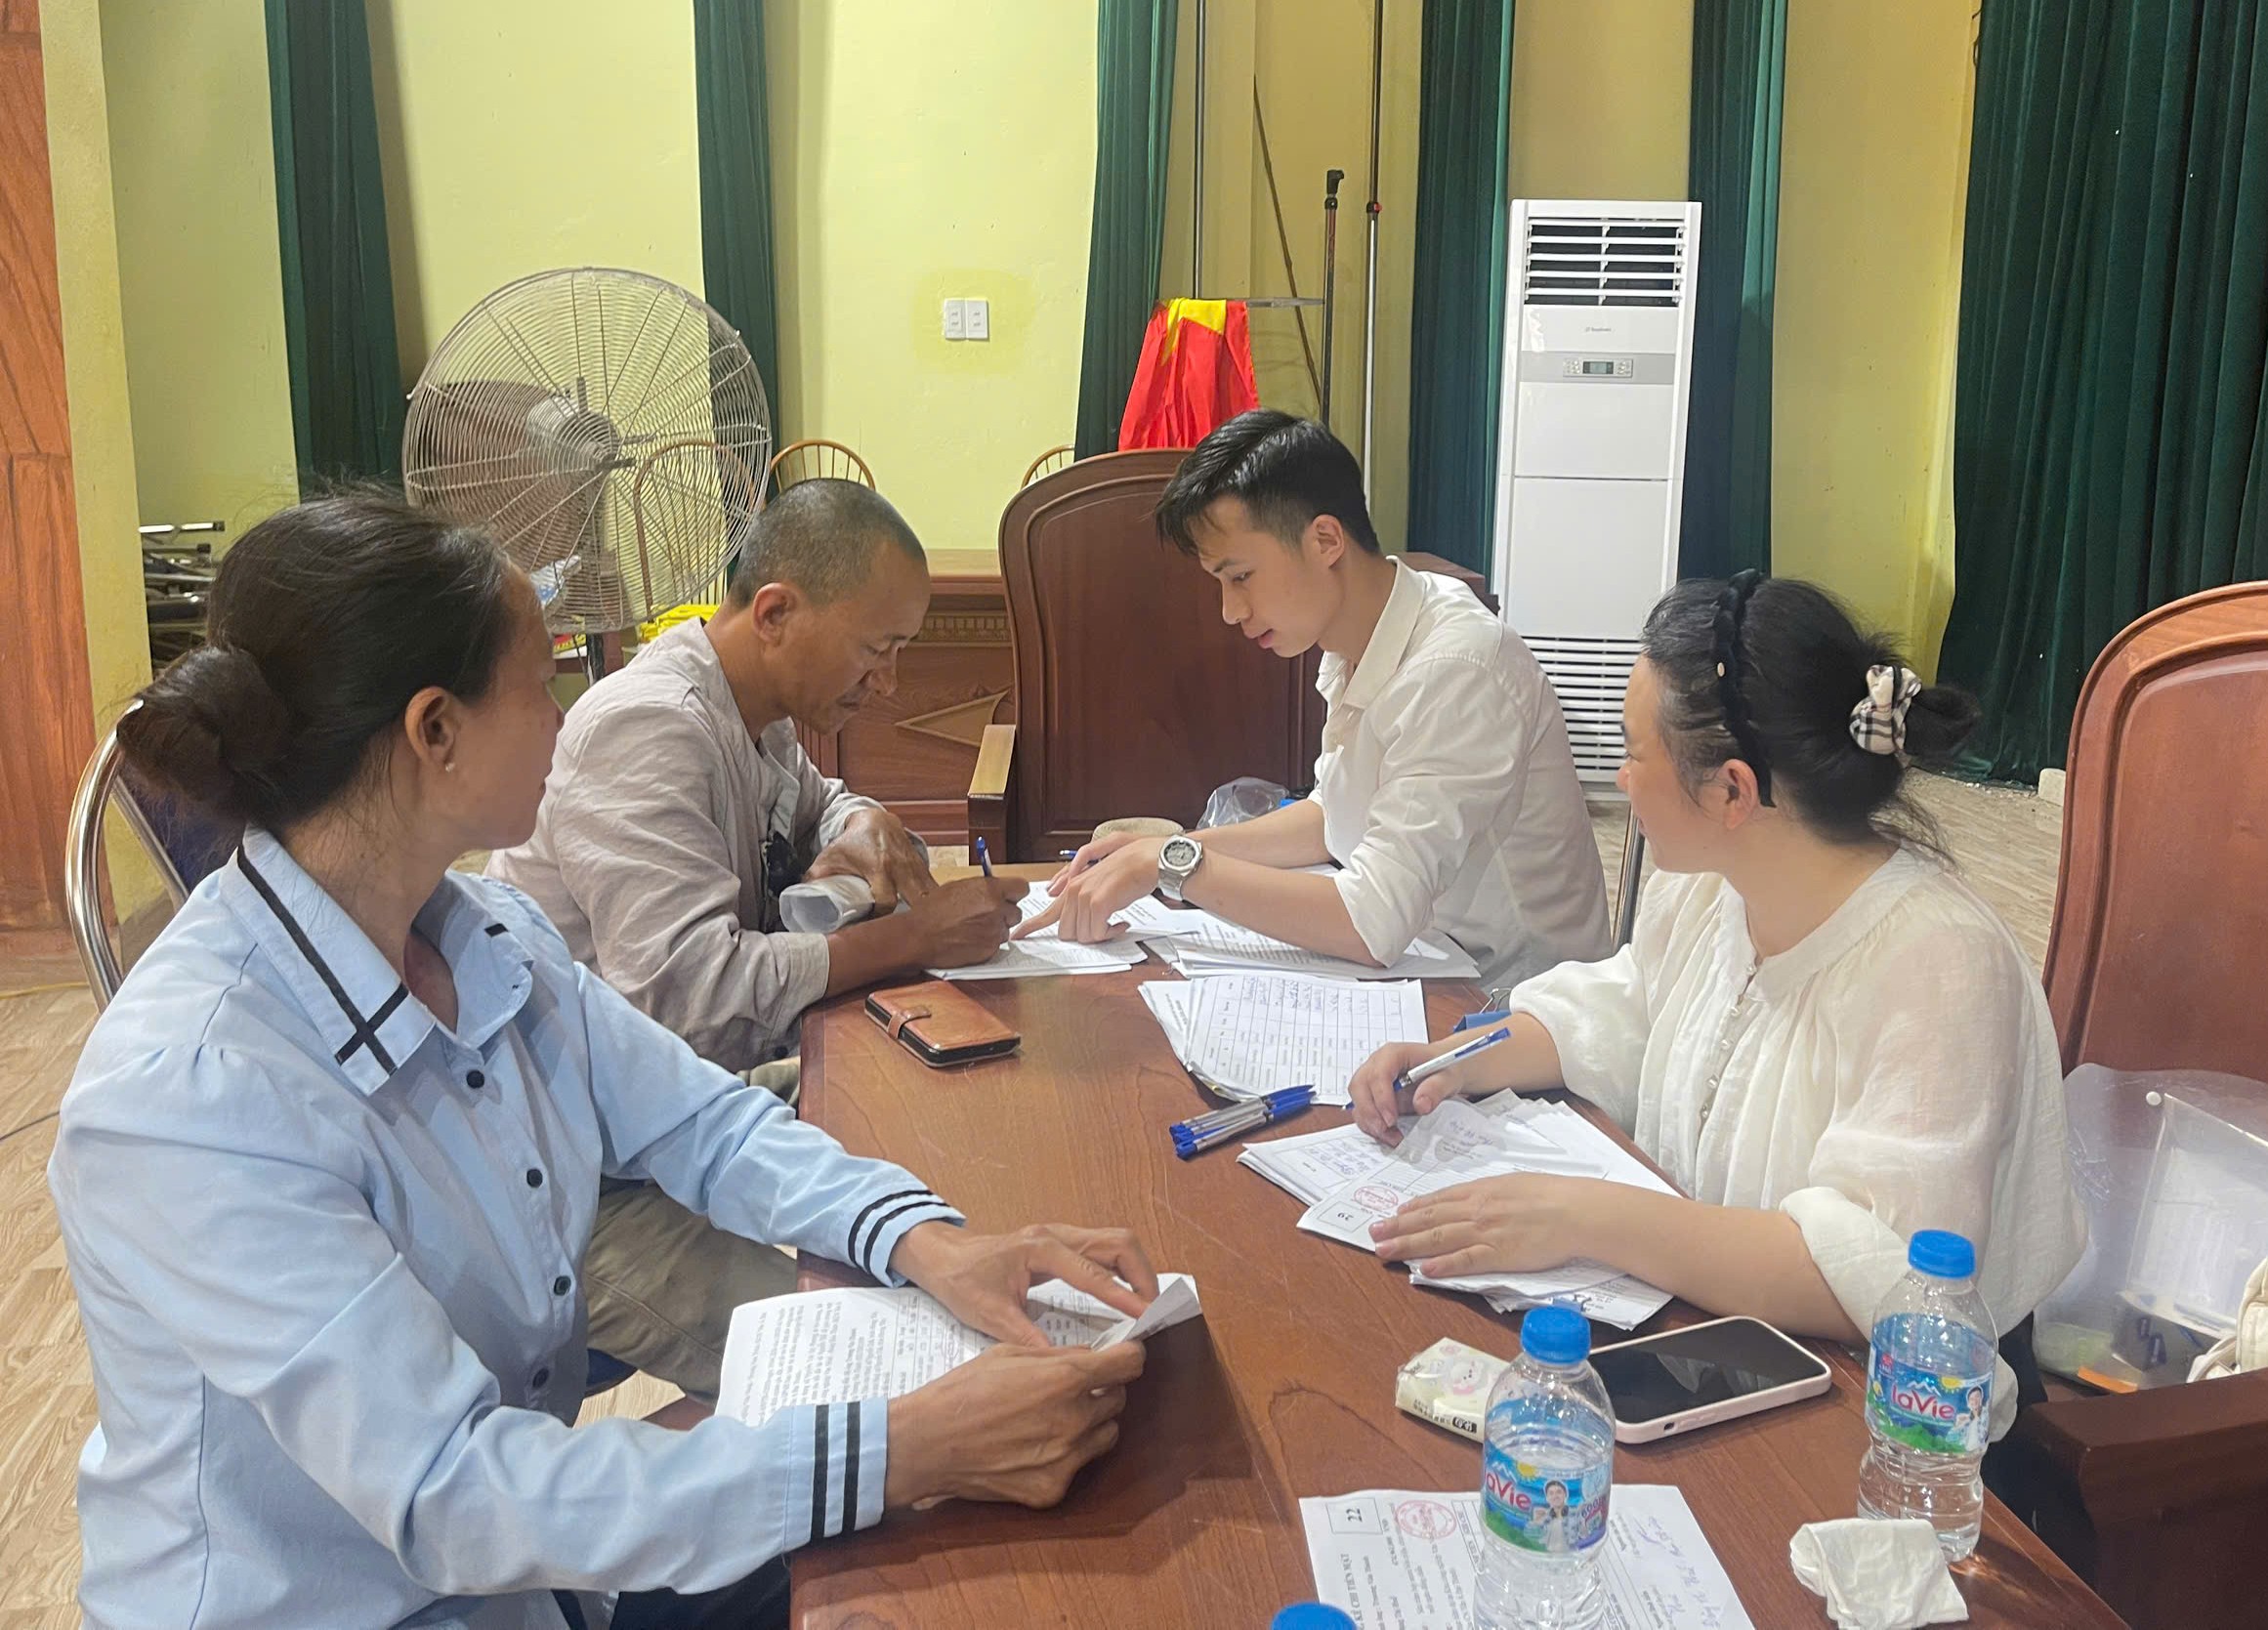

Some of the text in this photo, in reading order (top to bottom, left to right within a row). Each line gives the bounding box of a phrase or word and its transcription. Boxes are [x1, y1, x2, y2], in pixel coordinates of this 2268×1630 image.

[1892, 1383, 1955, 1419] laVie
[1485, 1471, 1532, 1511] aVie
[1346, 1508, 1363, 1522] 22
